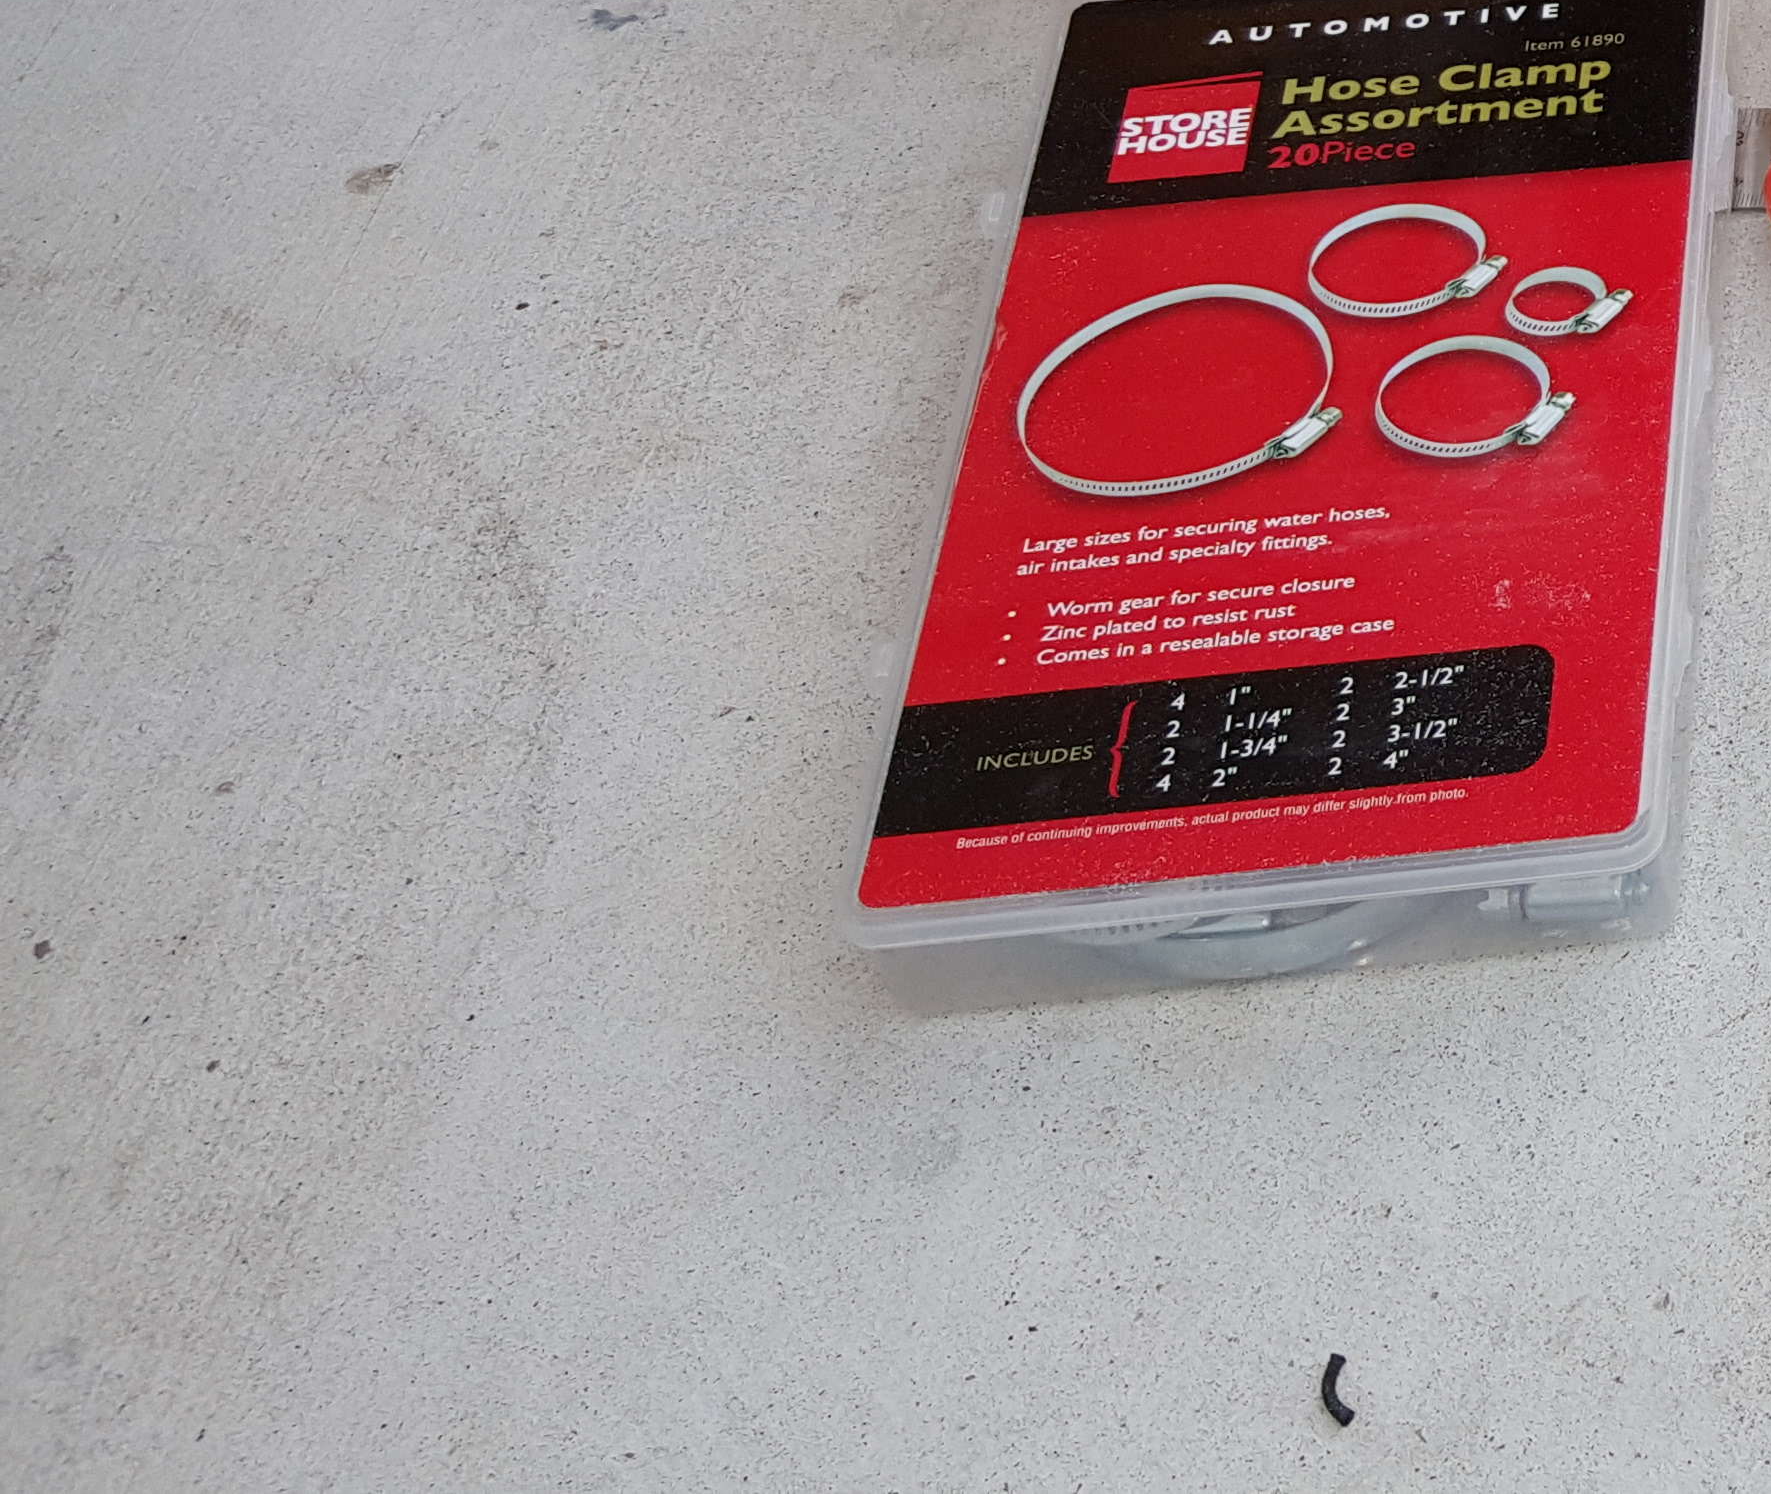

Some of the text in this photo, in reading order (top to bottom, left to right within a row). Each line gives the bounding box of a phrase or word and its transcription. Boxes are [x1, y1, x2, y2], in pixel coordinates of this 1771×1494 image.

[1209, 3, 1560, 46] AUTOMOTIVE
[1524, 32, 1625, 53] Item 61890
[1281, 59, 1612, 106] Hose Clamp
[1122, 106, 1254, 138] STORE
[1270, 87, 1605, 139] Assortment
[1115, 125, 1248, 156] HOUSE
[1022, 505, 1391, 555] Large sizes for securing water hoses,
[1016, 531, 1334, 577] air intakes and specialty fittings.
[1047, 575, 1356, 618] Worm gear for secure closure
[1035, 618, 1395, 667] Comes in a resealable storage case
[1039, 603, 1297, 643] Zinc plated to resist rust
[1170, 693, 1185, 712] 4
[1339, 676, 1355, 695] 2
[1393, 665, 1465, 689] 2-1/2"
[1165, 696, 1417, 739] 2 1-1/4" 2 3"
[975, 744, 1095, 772] INCLUDES
[1161, 718, 1458, 766] 2 1-3/4" 2 3-1/2"
[1155, 749, 1409, 793] 4 2" 2 4"
[956, 834, 1008, 850] Because
[1010, 831, 1026, 844] of
[1026, 823, 1092, 844] continuing
[1192, 811, 1230, 827] actual
[1232, 806, 1280, 825] product
[1283, 803, 1310, 818] may
[1313, 799, 1347, 815] differ
[1349, 794, 1395, 812] slightly
[1397, 792, 1427, 806] from
[1429, 787, 1470, 803] photo.
